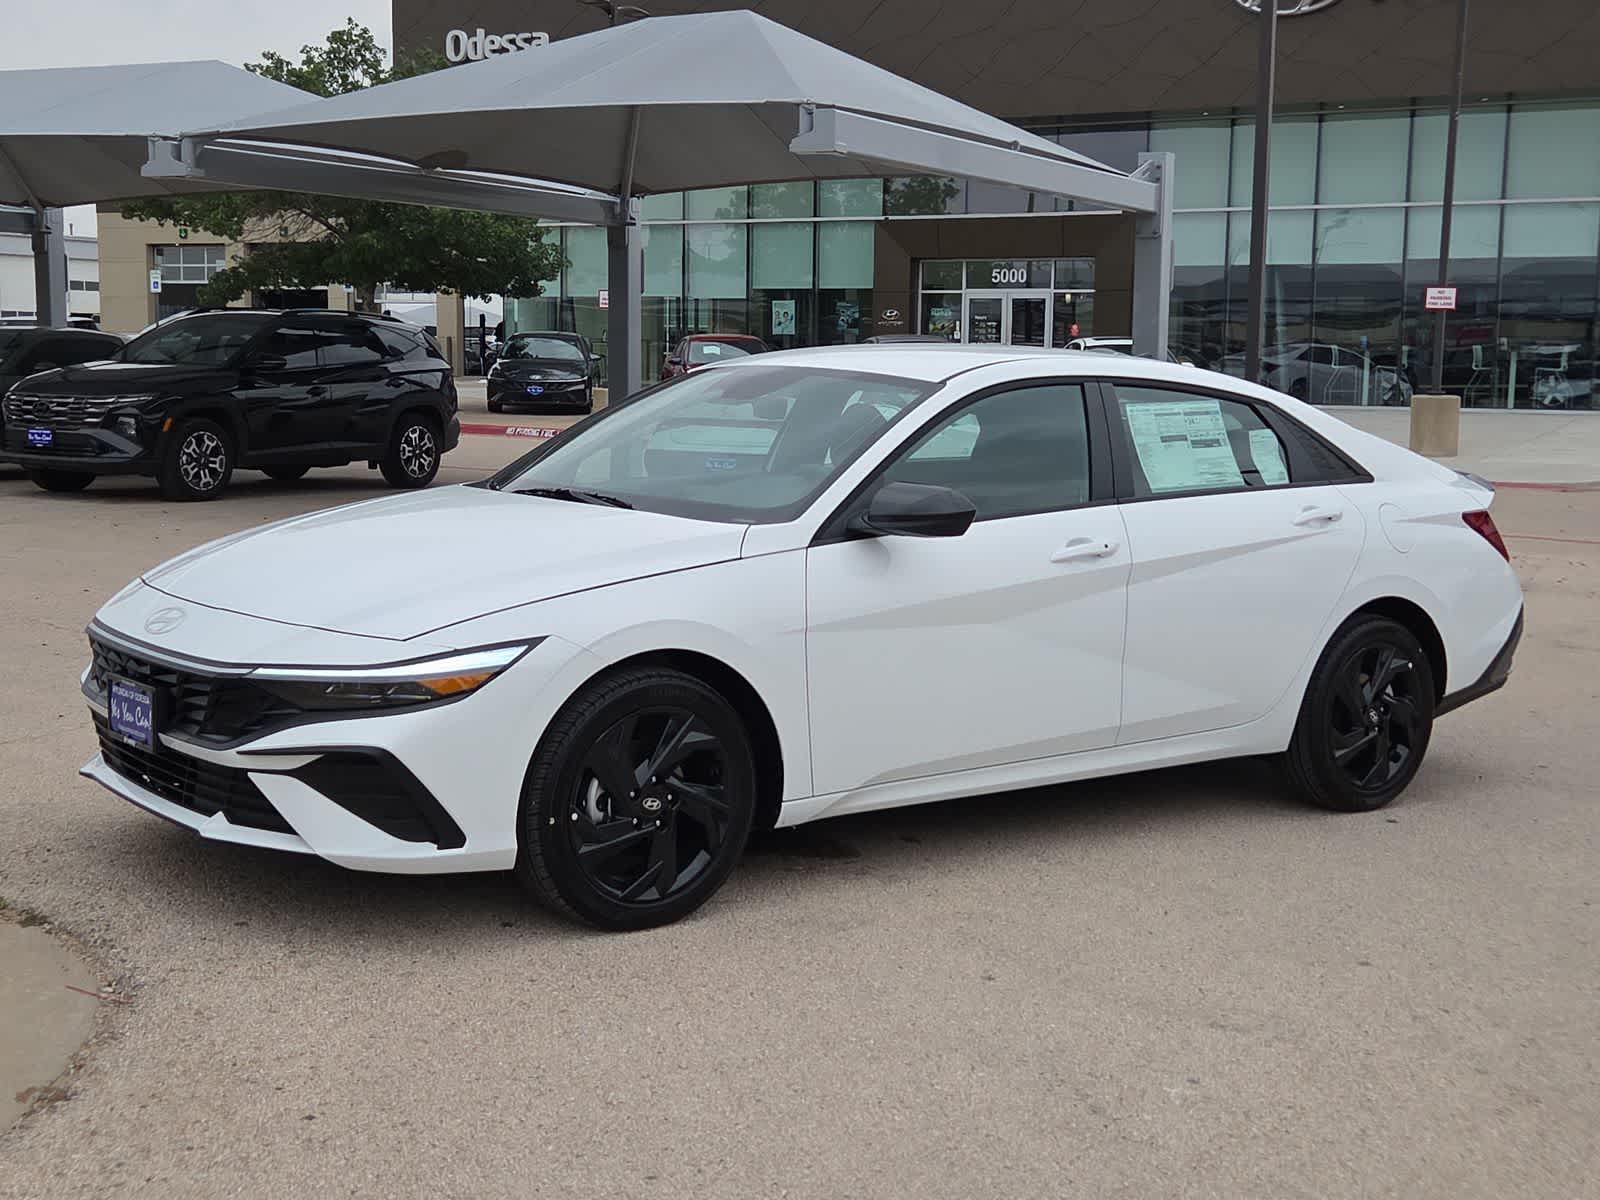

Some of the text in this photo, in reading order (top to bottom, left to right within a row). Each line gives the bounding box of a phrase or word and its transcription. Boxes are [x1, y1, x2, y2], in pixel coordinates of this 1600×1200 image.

[445, 27, 550, 62] Odessa
[991, 268, 1027, 283] 5000
[121, 701, 135, 722] You
